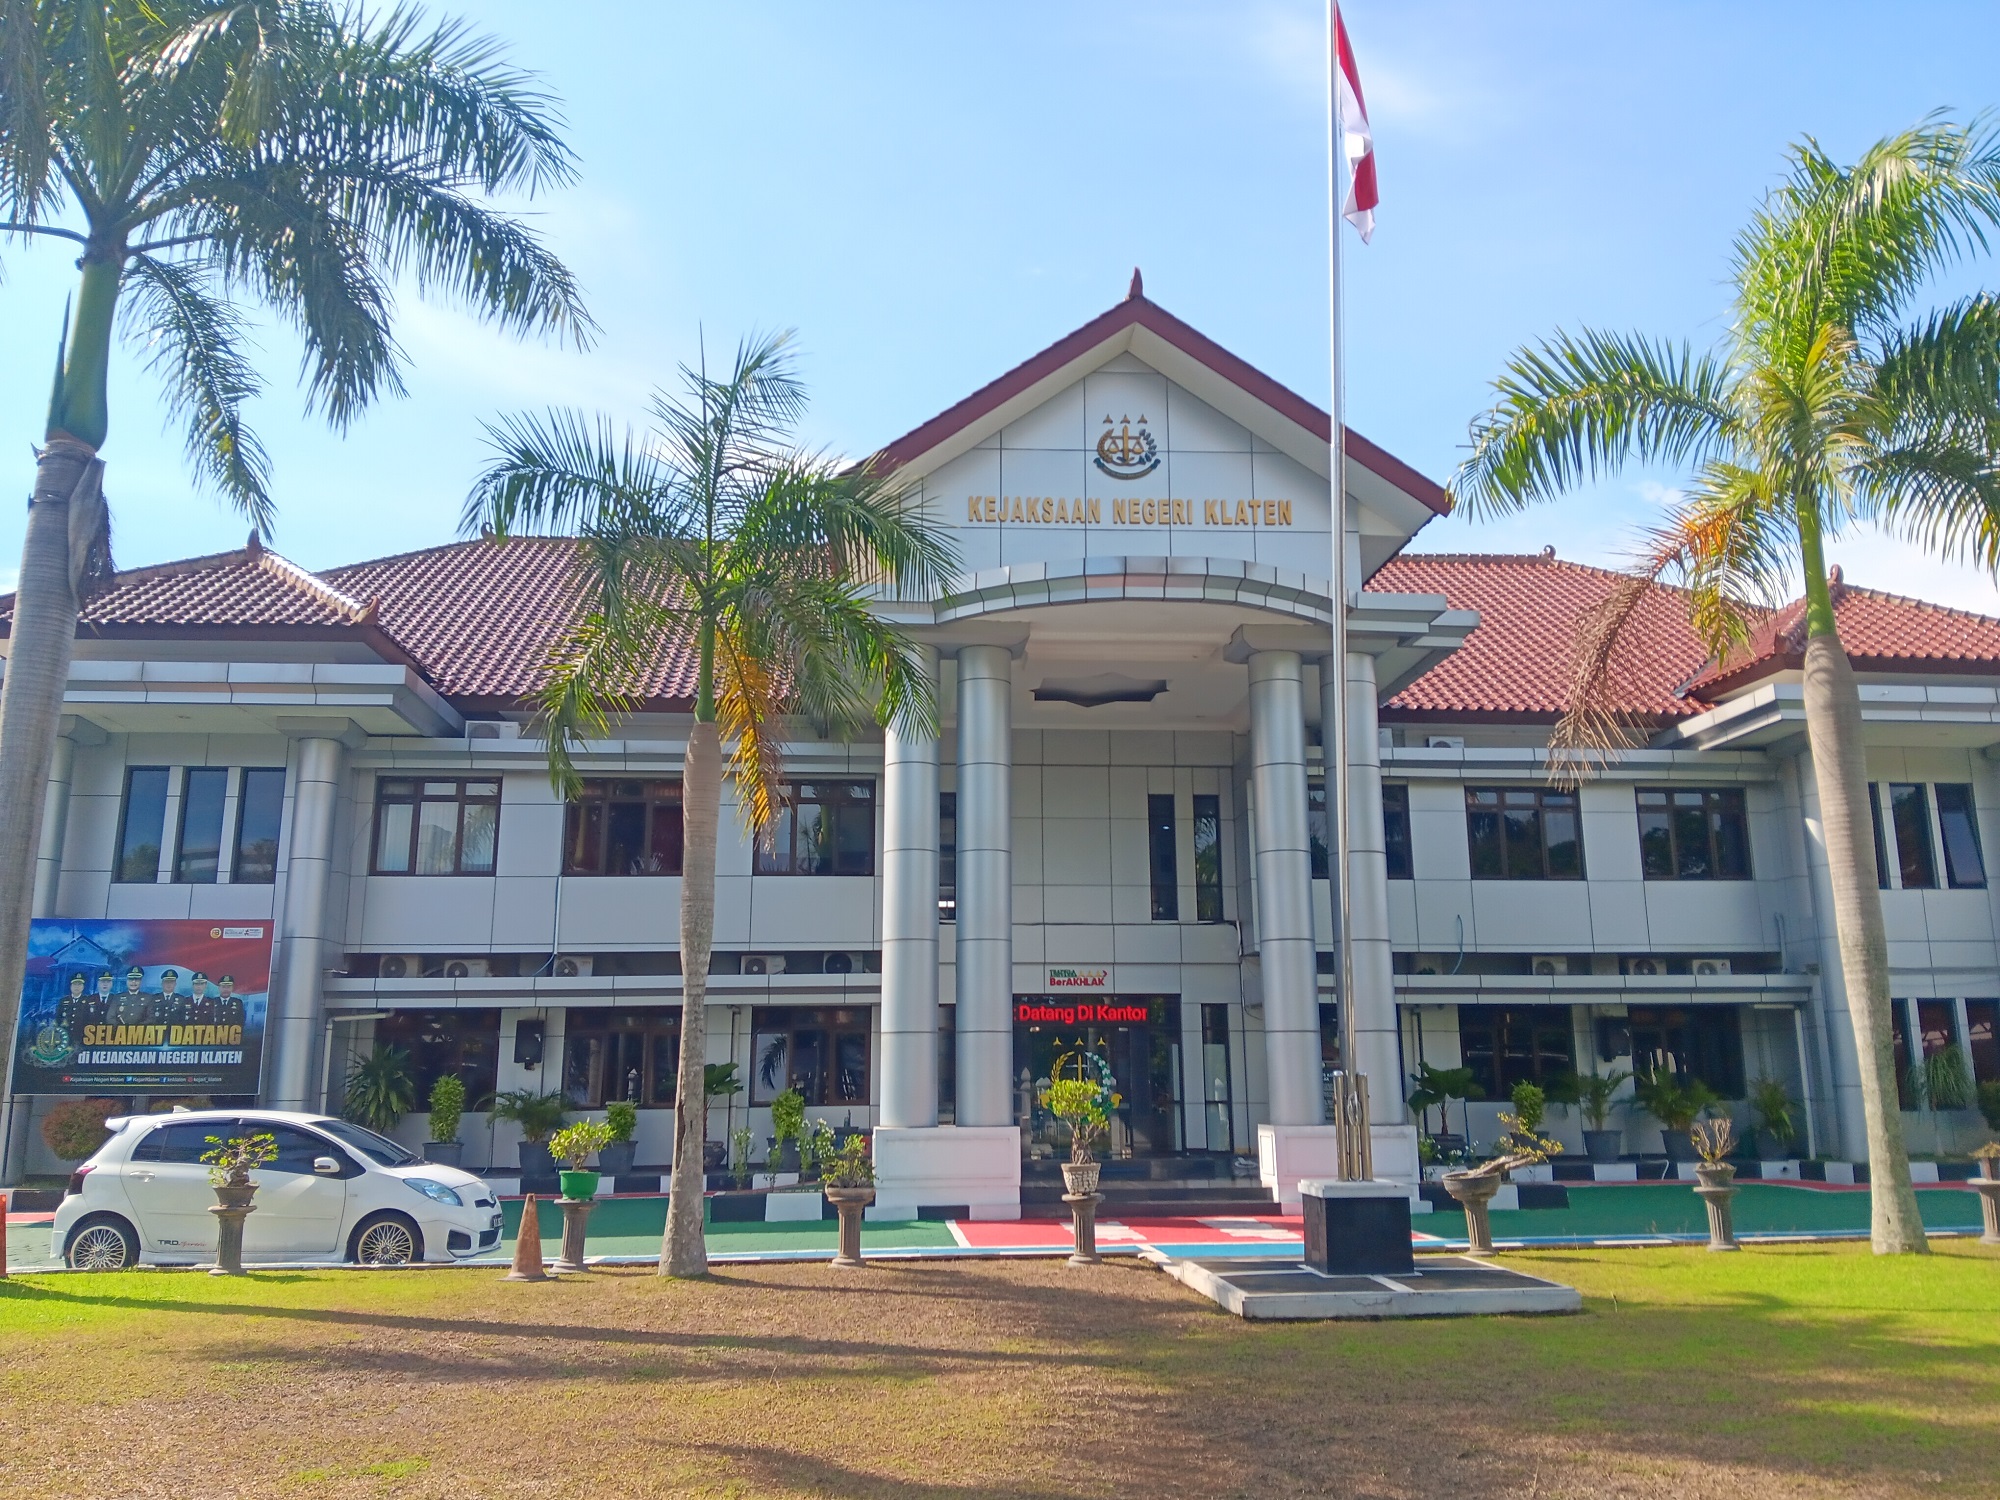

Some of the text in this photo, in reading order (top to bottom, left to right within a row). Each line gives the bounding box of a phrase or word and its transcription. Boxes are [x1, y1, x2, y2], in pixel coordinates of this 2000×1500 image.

[968, 496, 1292, 526] KEJAKSAAN NEGERI KLATEN
[1049, 977, 1105, 986] BerAKHLAK
[1020, 1005, 1074, 1024] Datang
[1078, 1005, 1094, 1021] Di
[1097, 1005, 1147, 1021] Kantor
[83, 1025, 242, 1046] SELAMAT DATANG
[77, 1051, 243, 1064] di KEJAKSAAN NEGERI KLATEN
